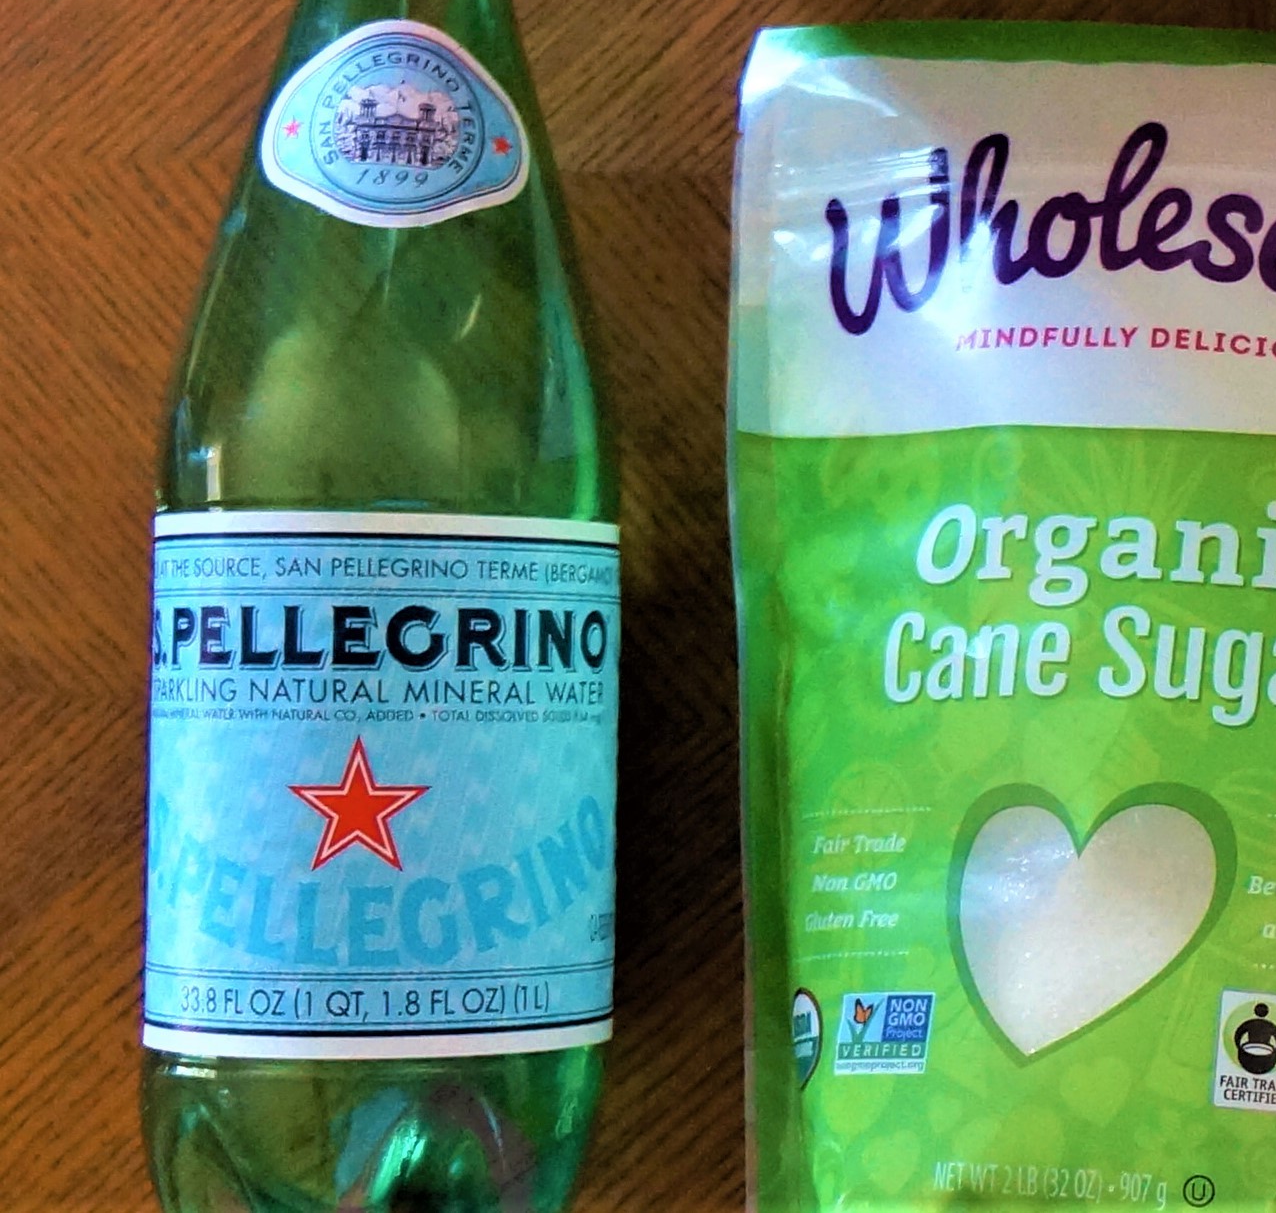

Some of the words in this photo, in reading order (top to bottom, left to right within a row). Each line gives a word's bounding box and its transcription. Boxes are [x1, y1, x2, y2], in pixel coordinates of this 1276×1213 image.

[322, 51, 460, 110] PELLEGRINO
[318, 121, 340, 167] SAN
[447, 99, 476, 174] TERME
[356, 168, 429, 185] 1899
[957, 325, 1140, 354] MINDFULLY
[275, 557, 322, 578] SAN
[330, 557, 468, 580] PELLEGRINO
[477, 559, 538, 581] TERME
[884, 611, 1073, 704] Cane
[249, 678, 389, 704] NATURAL
[403, 679, 536, 705] MINERAL
[854, 872, 897, 891] GMO
[249, 989, 284, 1015] OZ
[889, 998, 928, 1013] NON
[887, 1013, 926, 1027] GMO
[842, 1044, 922, 1058] VERIFIED
